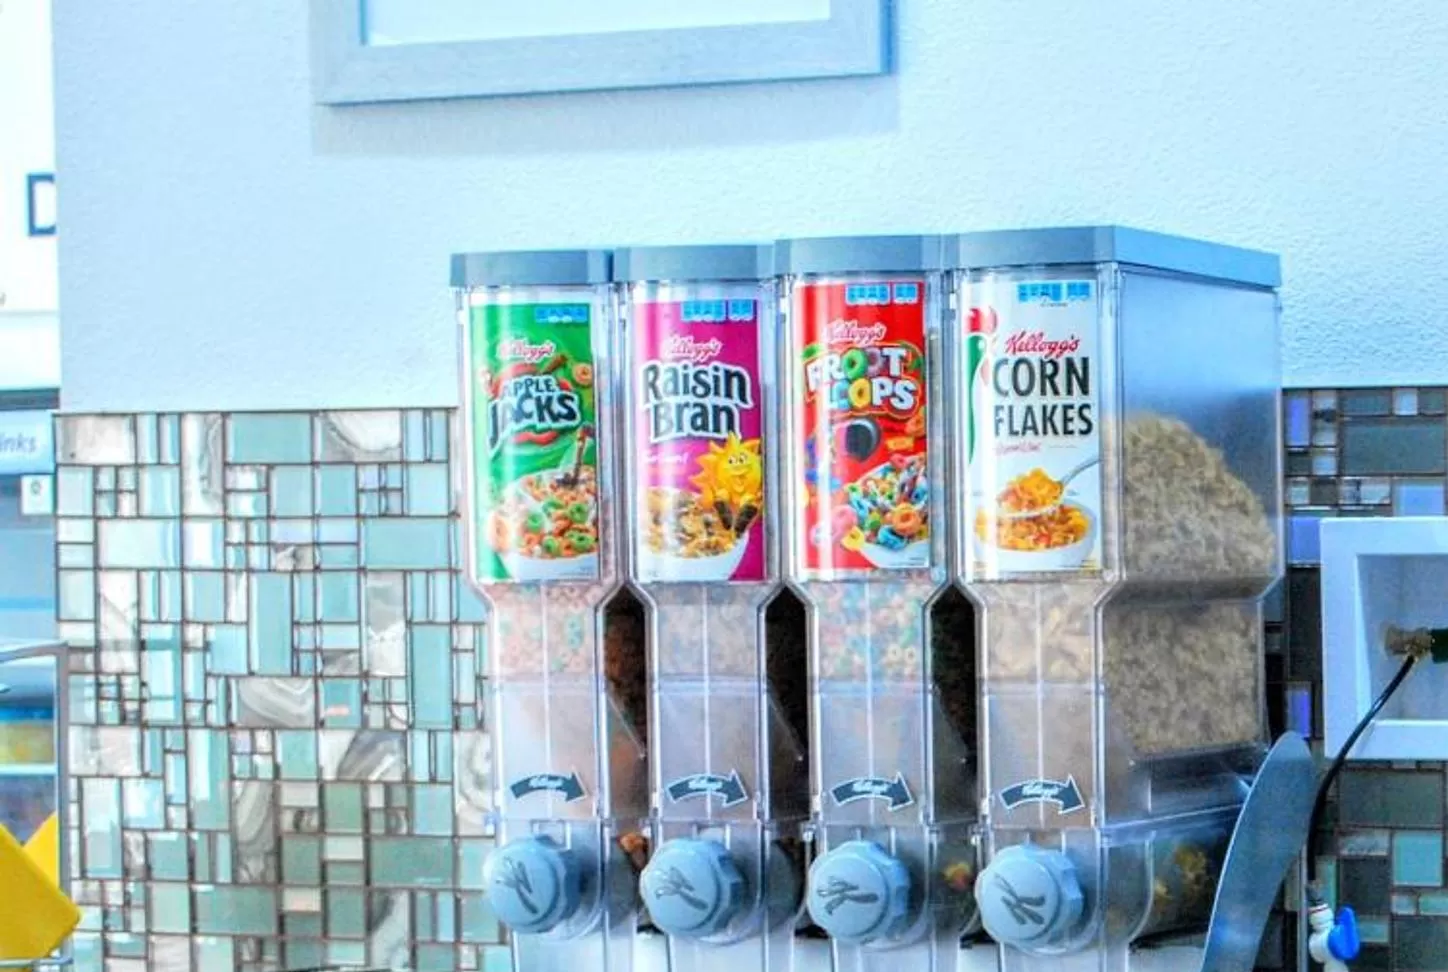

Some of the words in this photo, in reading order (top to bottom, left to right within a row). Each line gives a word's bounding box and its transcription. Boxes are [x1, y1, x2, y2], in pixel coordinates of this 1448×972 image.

[1005, 330, 1081, 360] Kellogg's
[643, 363, 749, 406] Raisin
[807, 346, 907, 393] FROOT
[992, 355, 1090, 398] CORN
[489, 392, 578, 448] JACKS
[653, 400, 736, 439] Bran
[993, 402, 1094, 438] FLAKES
